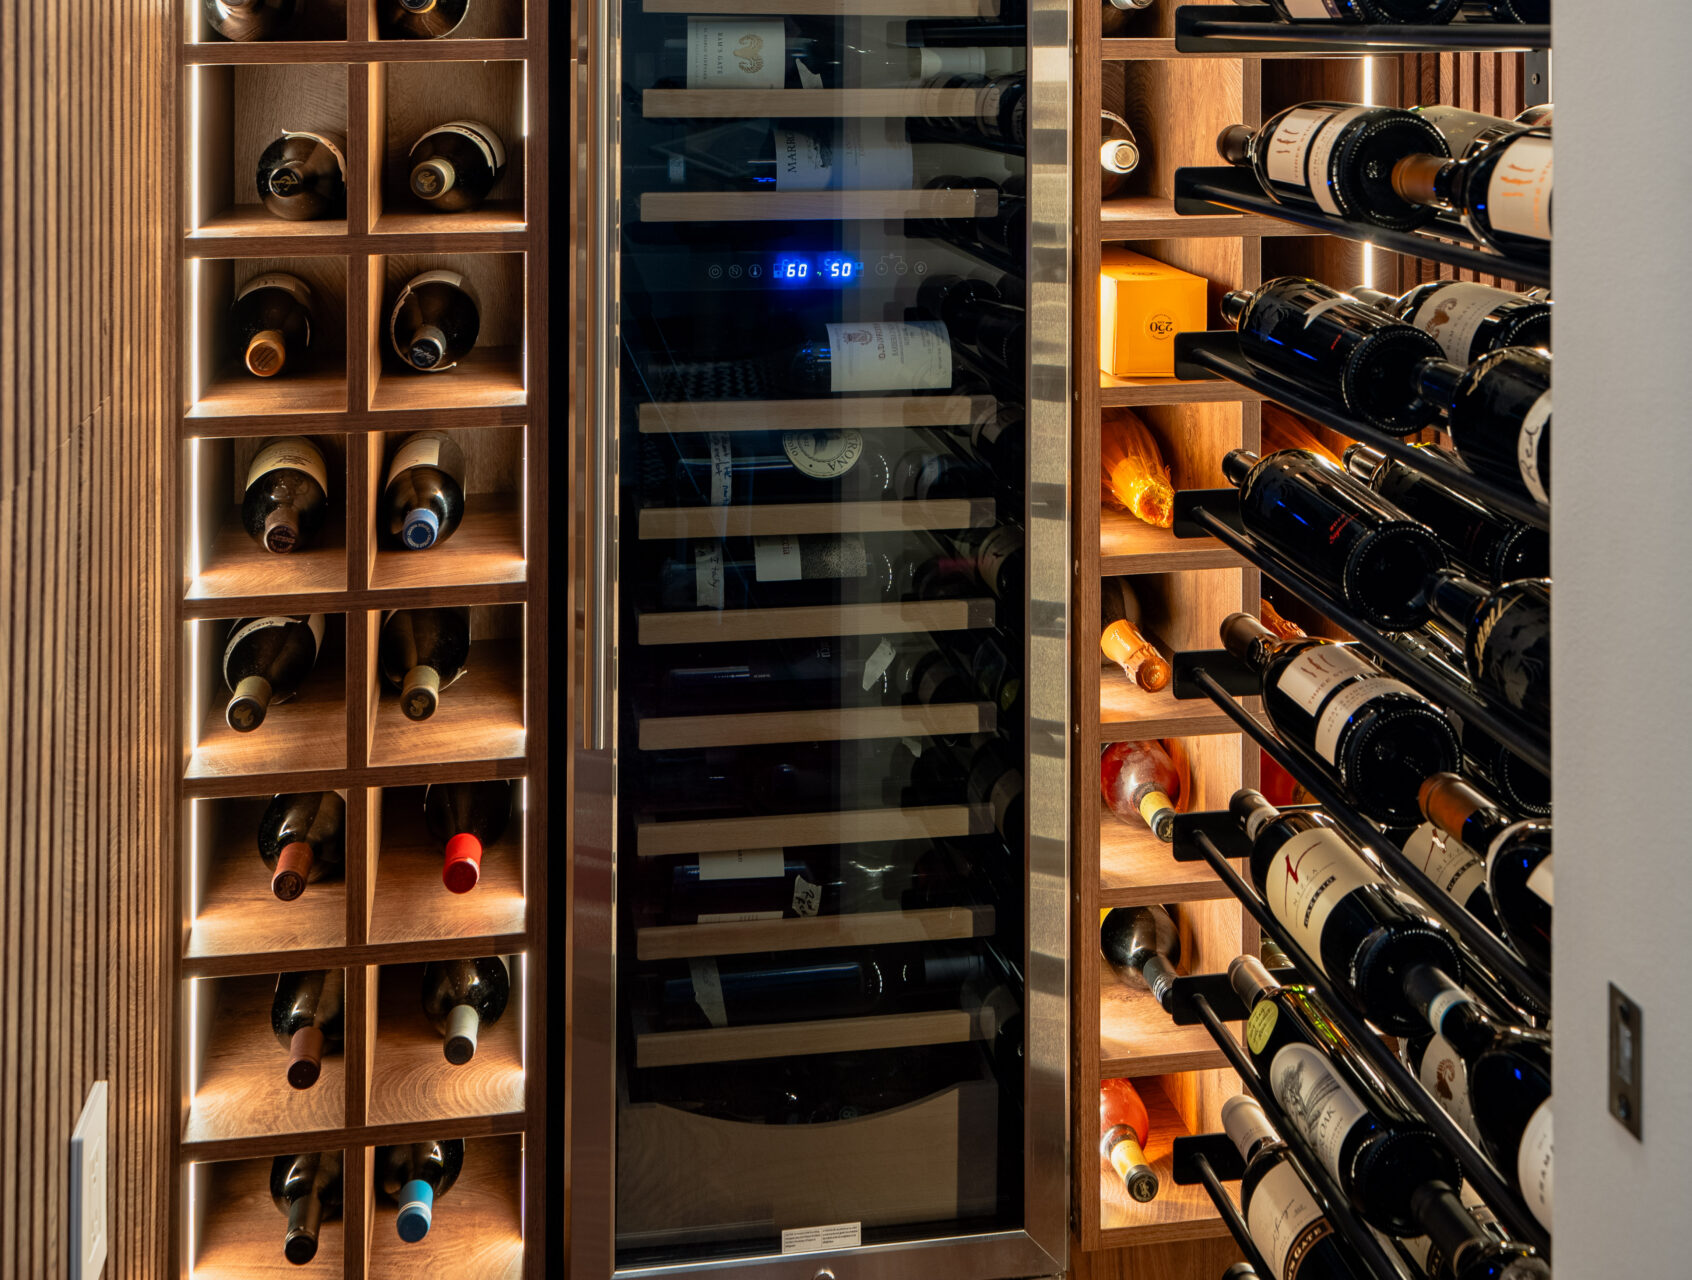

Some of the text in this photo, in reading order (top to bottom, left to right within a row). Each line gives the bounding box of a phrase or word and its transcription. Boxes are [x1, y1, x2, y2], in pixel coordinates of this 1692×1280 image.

[786, 262, 852, 277] 60 50
[1149, 321, 1173, 335] 250
[1520, 424, 1540, 482] Red
[1319, 1108, 1337, 1137] OAK
[1294, 1227, 1323, 1259] GATE
